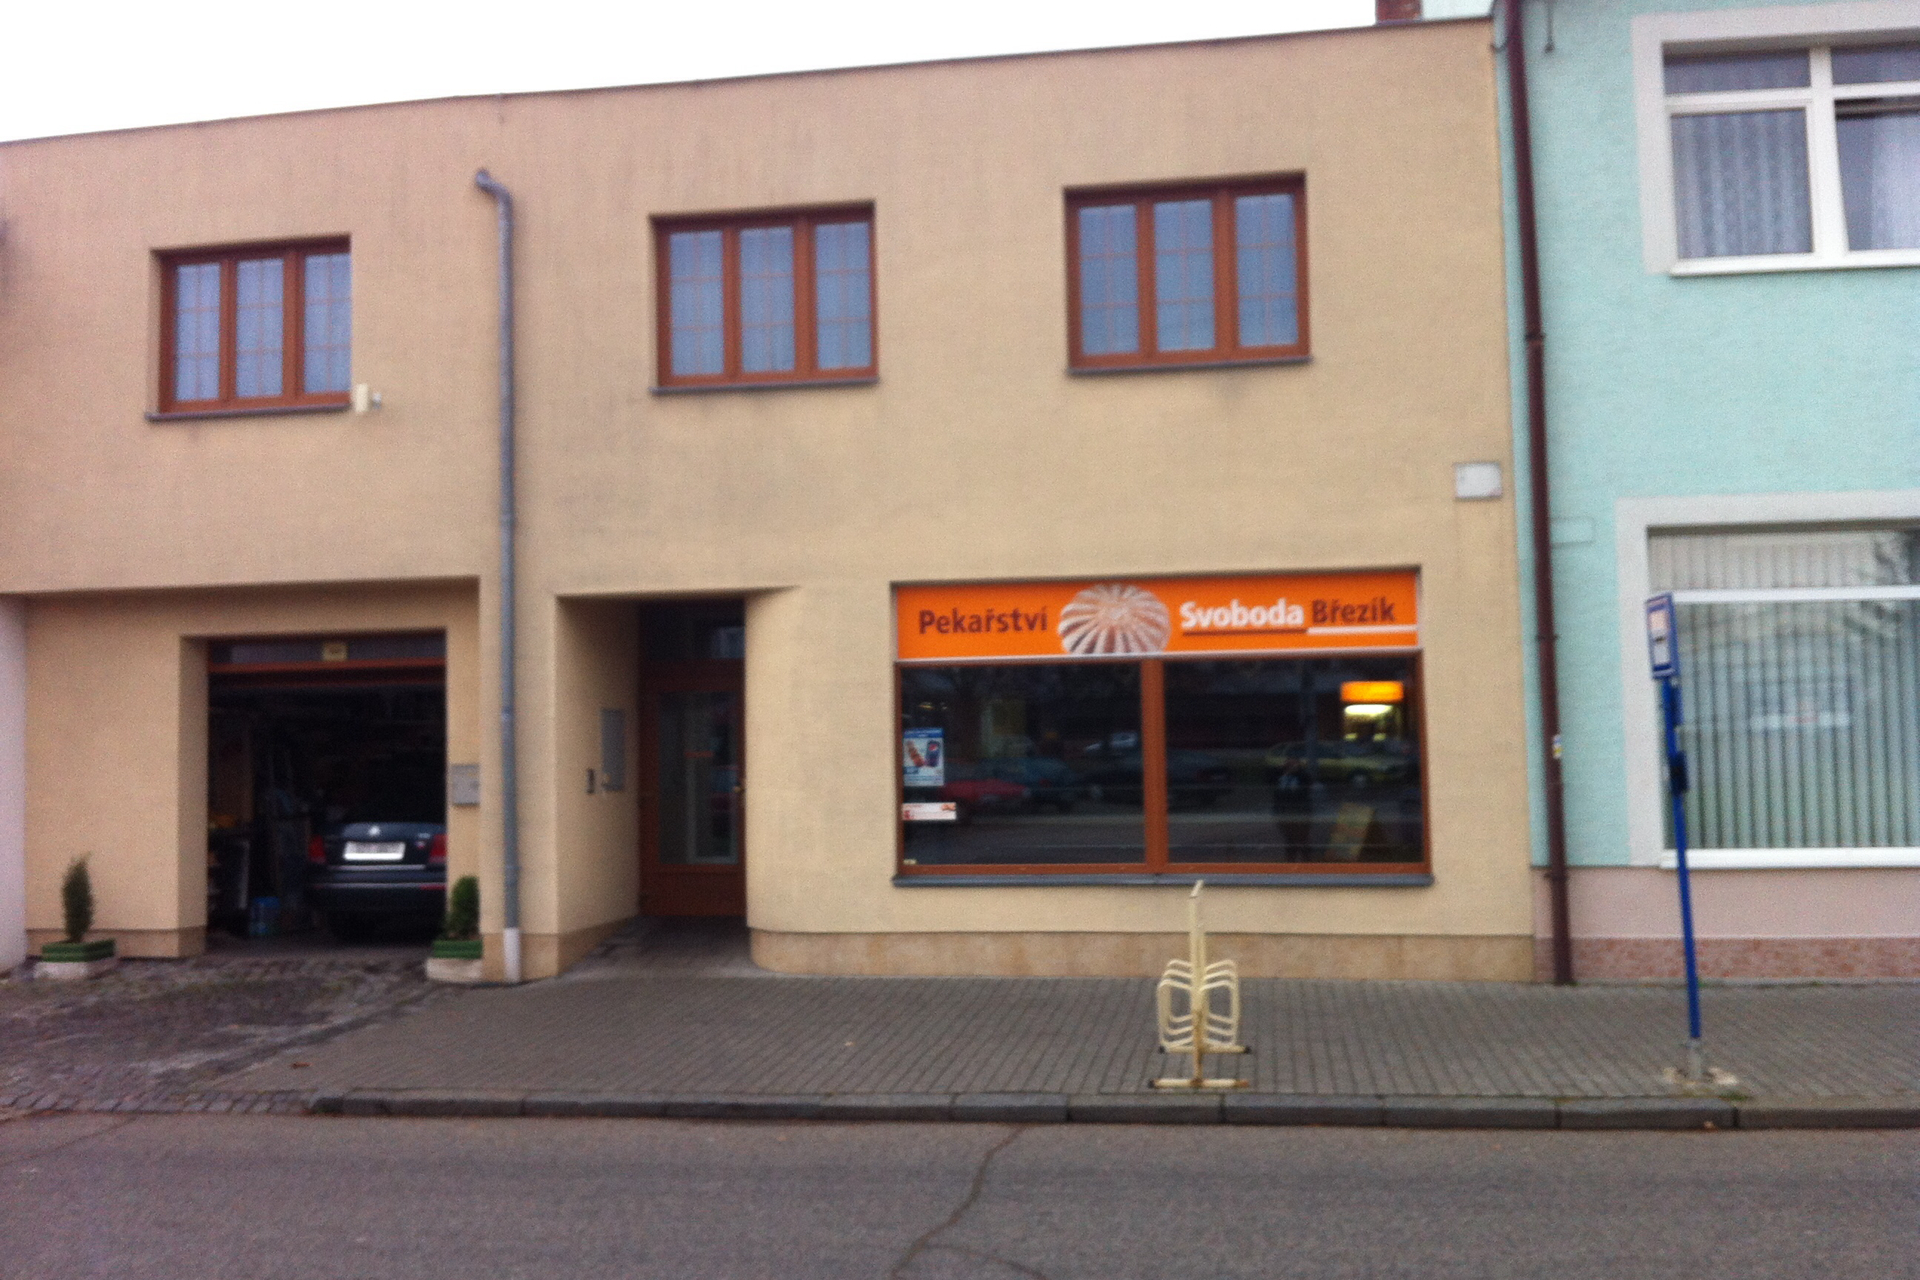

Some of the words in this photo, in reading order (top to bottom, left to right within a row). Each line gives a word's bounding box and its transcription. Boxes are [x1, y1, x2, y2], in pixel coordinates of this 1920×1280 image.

[919, 606, 1048, 634] Pekařství
[1179, 598, 1304, 629] Svoboda
[1312, 597, 1395, 624] Březík
